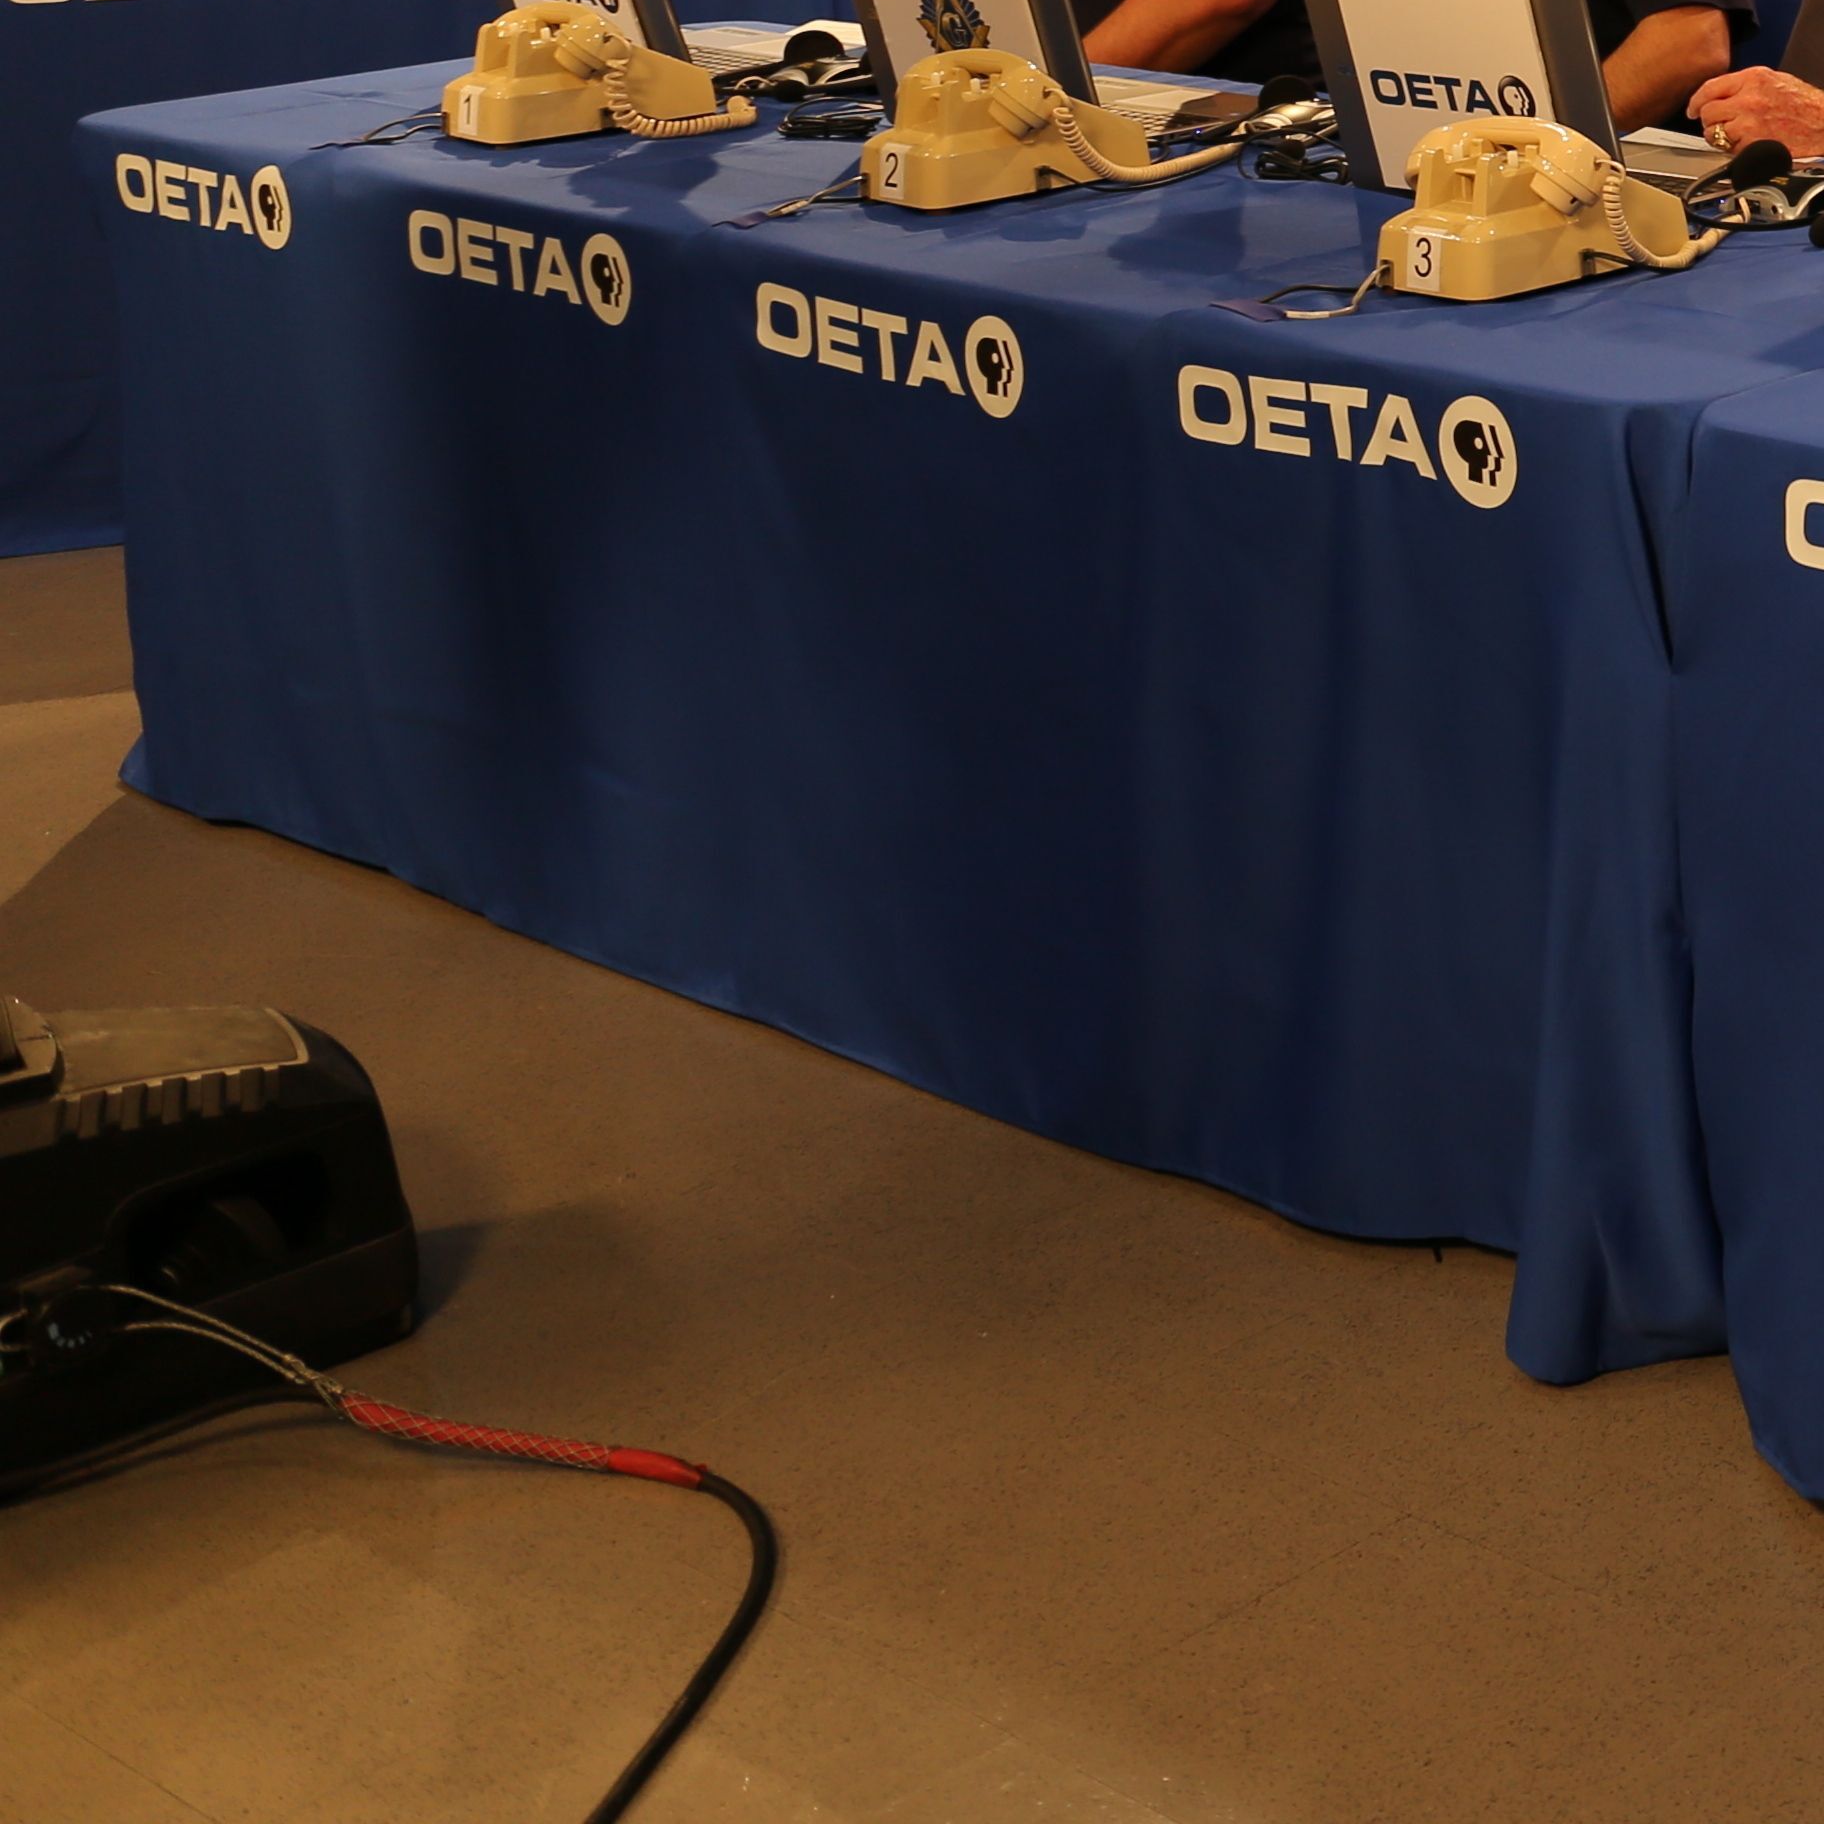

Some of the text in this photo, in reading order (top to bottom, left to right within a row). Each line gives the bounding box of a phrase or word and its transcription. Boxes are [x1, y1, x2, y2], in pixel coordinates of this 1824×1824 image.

[463, 94, 472, 125] 1
[1370, 69, 1500, 116] OETA
[116, 153, 254, 235] OETA
[884, 152, 899, 188] 2
[409, 209, 583, 305] OETA
[1414, 237, 1432, 278] 3
[756, 282, 965, 395] OETA
[1178, 364, 1437, 481] OETA
